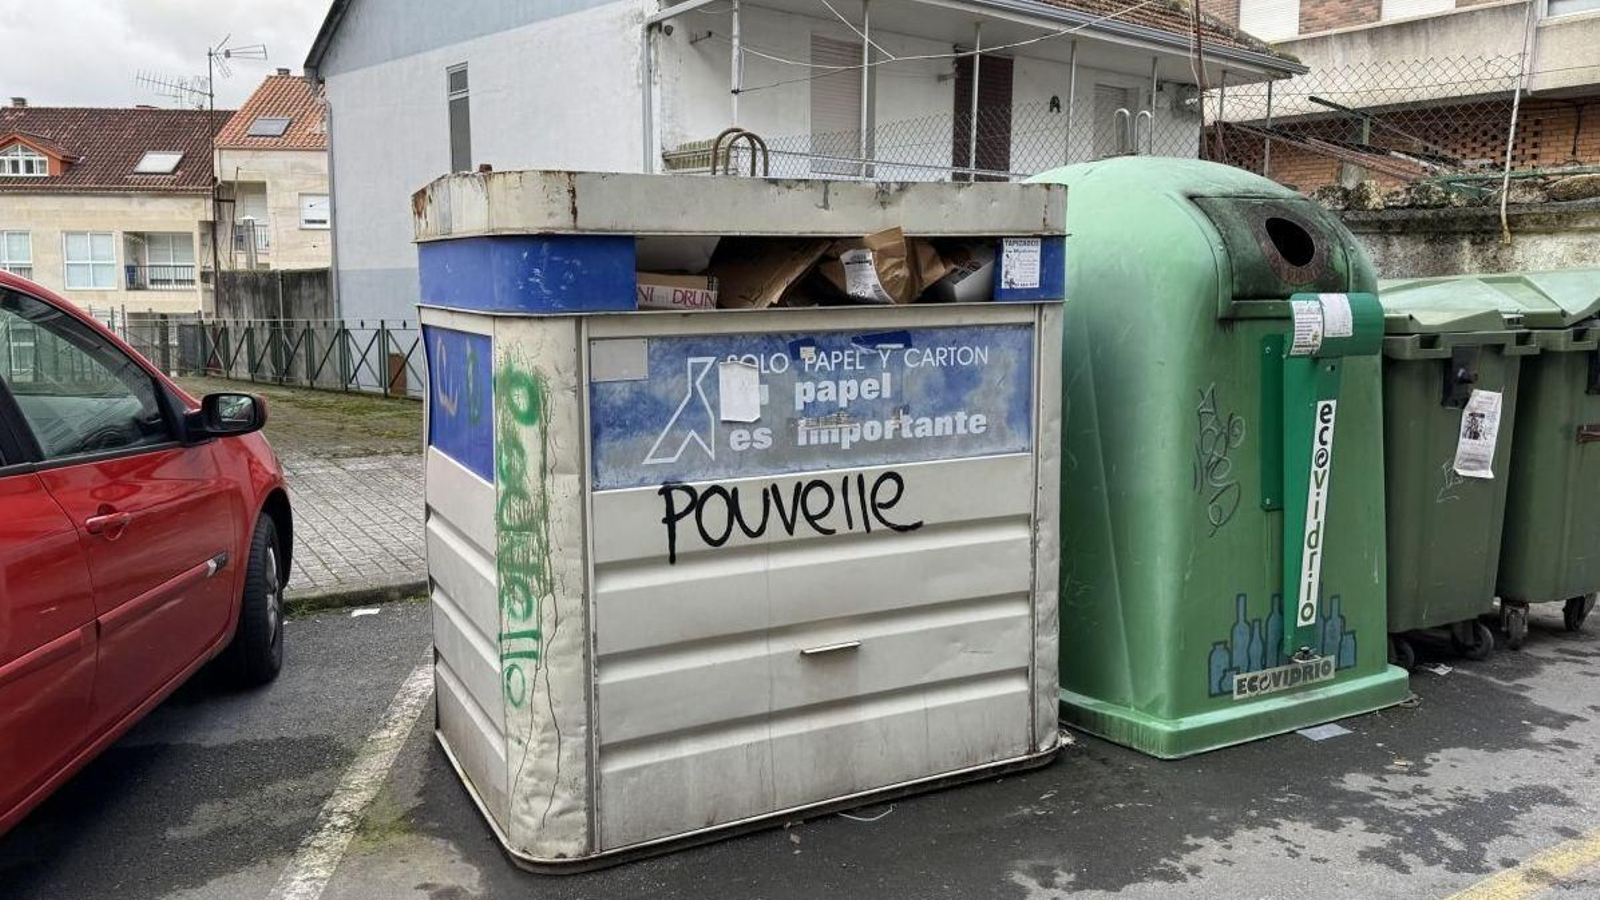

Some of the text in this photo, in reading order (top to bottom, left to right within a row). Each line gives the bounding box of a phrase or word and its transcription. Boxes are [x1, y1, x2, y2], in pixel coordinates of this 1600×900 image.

[803, 350, 865, 373] PAPEL
[879, 349, 892, 369] Y
[903, 345, 989, 368] CARTON
[795, 372, 891, 410] papel
[729, 411, 987, 451] es importante
[1236, 659, 1333, 696] ECOVIDRIO
